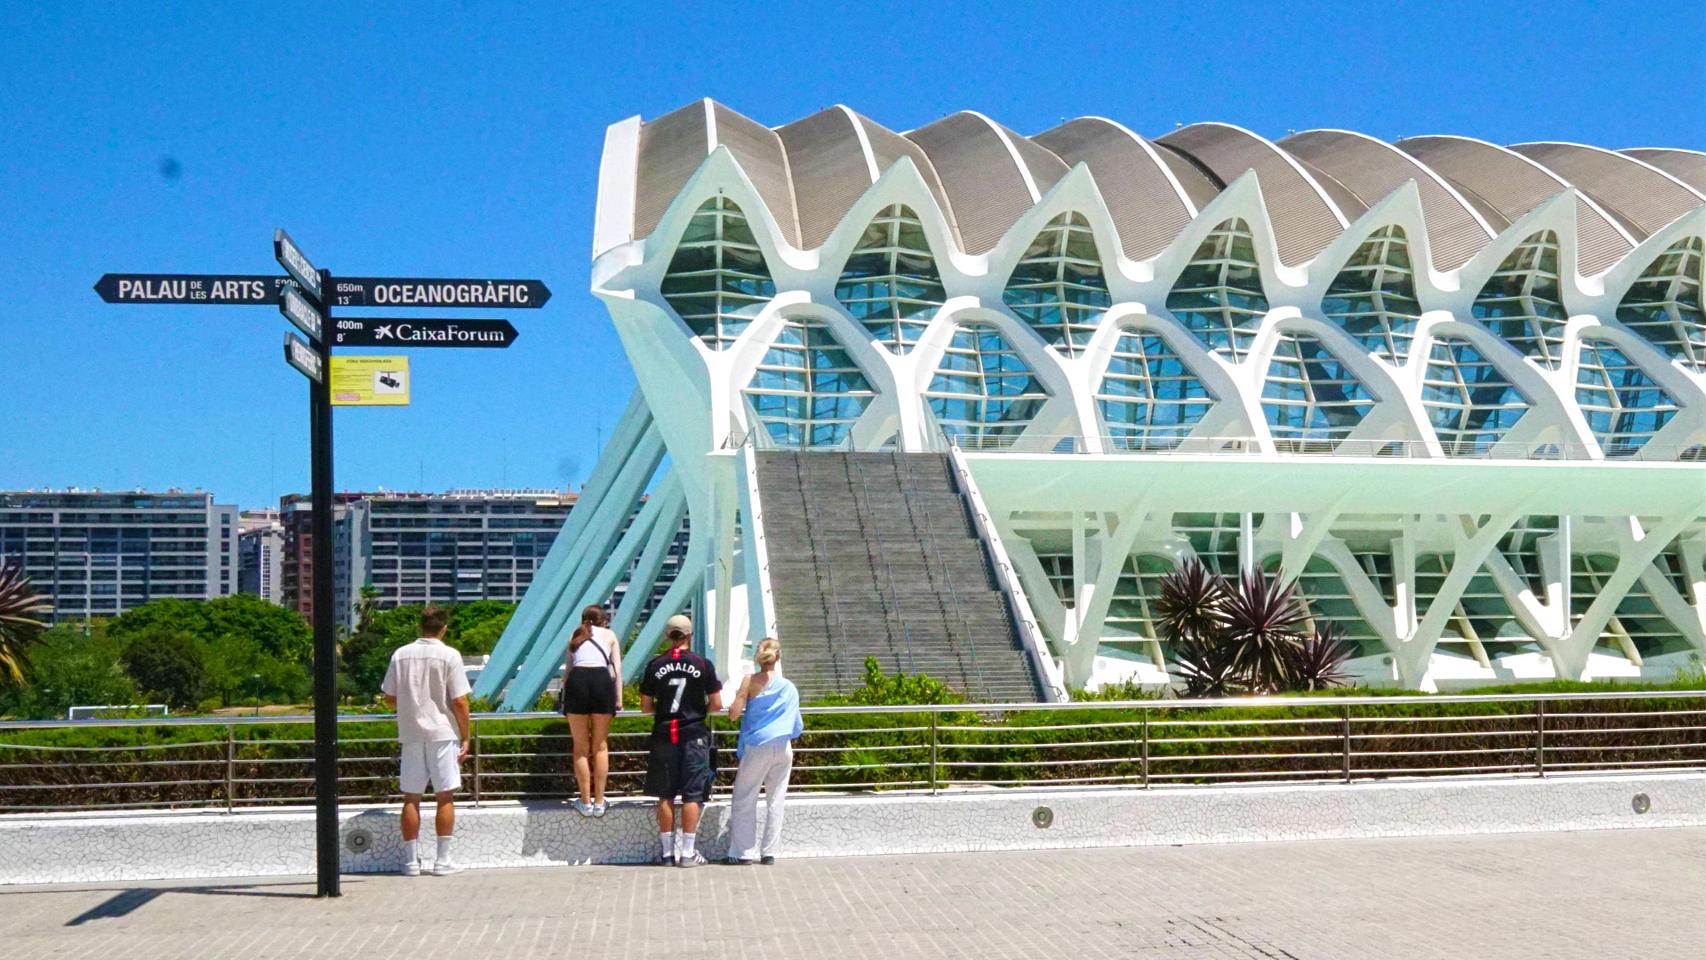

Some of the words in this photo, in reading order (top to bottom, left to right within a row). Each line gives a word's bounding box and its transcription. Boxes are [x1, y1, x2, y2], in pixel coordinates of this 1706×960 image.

[118, 280, 187, 299] PALAU
[190, 281, 202, 290] DE
[190, 290, 207, 299] LES
[210, 280, 265, 299] ARTS
[337, 283, 363, 292] 650m
[374, 281, 529, 303] OCEANOGRÀFIC
[336, 320, 363, 330] 400m
[396, 323, 505, 341] CaixaForum
[655, 662, 701, 680] RONALDO
[668, 677, 687, 713] 7
